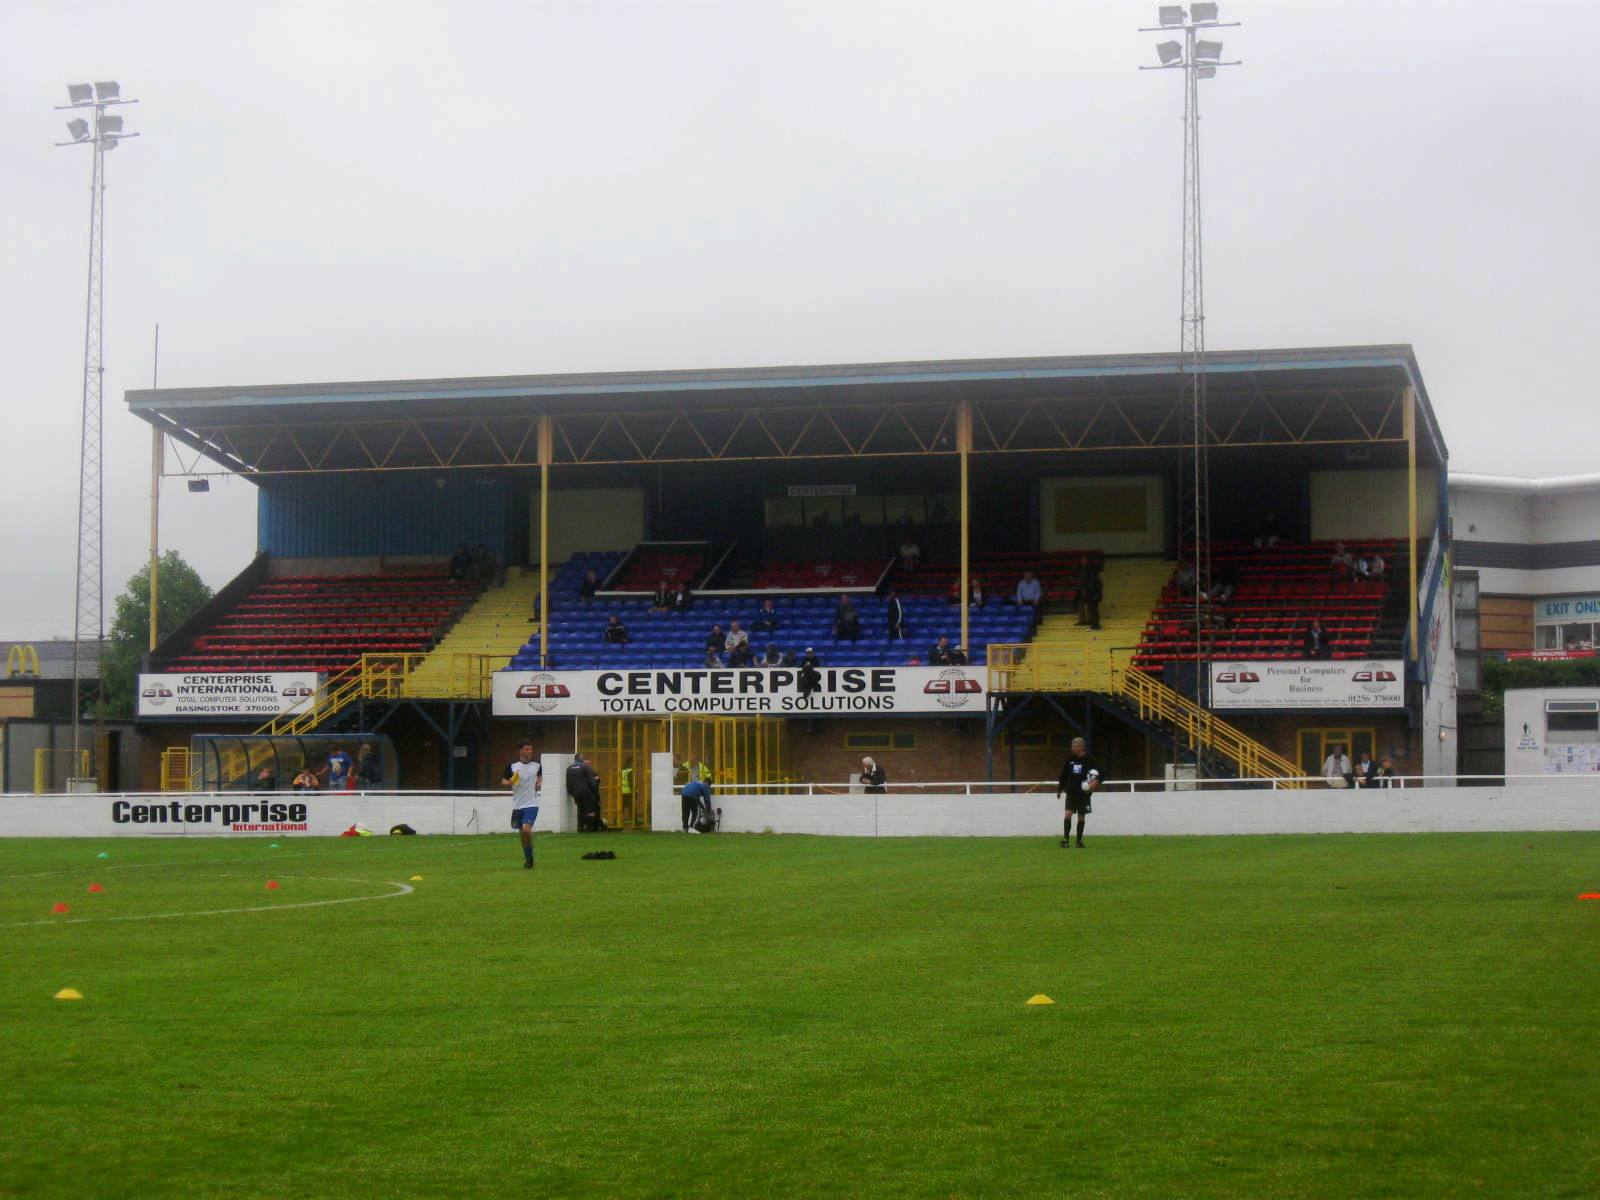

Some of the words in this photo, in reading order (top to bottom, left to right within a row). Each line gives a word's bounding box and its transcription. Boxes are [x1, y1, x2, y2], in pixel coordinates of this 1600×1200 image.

[1546, 602, 1569, 615] EXIT
[1575, 600, 1600, 614] ONL
[1267, 667, 1300, 675] Personal
[1303, 666, 1346, 676] Computers
[183, 675, 273, 685] CENTERPRISE
[176, 685, 279, 694] INTERNATIONAL
[1289, 685, 1323, 693] Business
[199, 695, 237, 703] COMPUTER
[239, 695, 278, 703] SOLUTIONS
[600, 698, 655, 712] TOTAL
[664, 697, 771, 711] COMPUTER
[781, 695, 895, 710] SOLUTIONS
[1348, 695, 1370, 703] 01256
[245, 704, 280, 712] 378000
[112, 800, 307, 825] Centerprise
[232, 823, 307, 832] International
